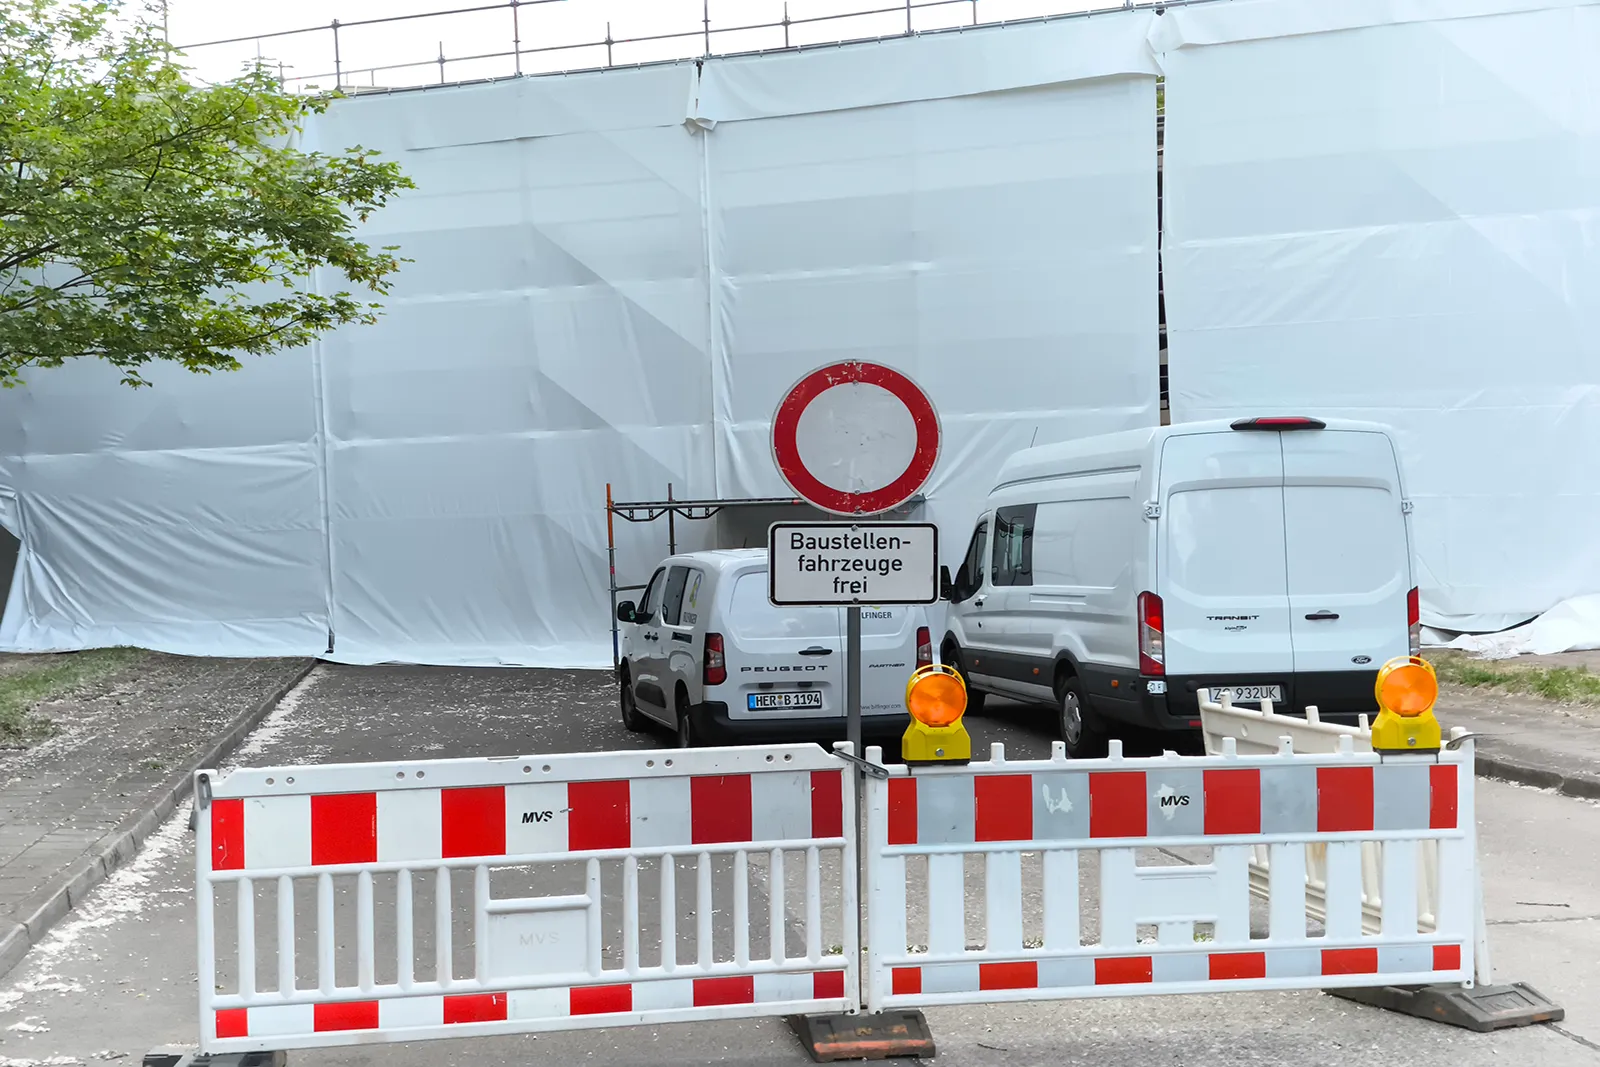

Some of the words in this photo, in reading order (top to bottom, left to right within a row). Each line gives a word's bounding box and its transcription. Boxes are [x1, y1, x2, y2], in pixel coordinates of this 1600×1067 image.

[790, 532, 912, 550] Baustellen-
[798, 555, 903, 576] fahrzeuge
[833, 576, 867, 594] frei
[860, 611, 893, 619] LFINGER
[740, 665, 828, 673] PEUGEOT
[1236, 686, 1277, 699] 932UK
[755, 695, 777, 707] HER
[784, 694, 792, 706] B
[793, 693, 820, 705] 1194
[1160, 795, 1190, 807] MVS
[521, 810, 554, 824] MVS
[519, 931, 561, 947] MVS
